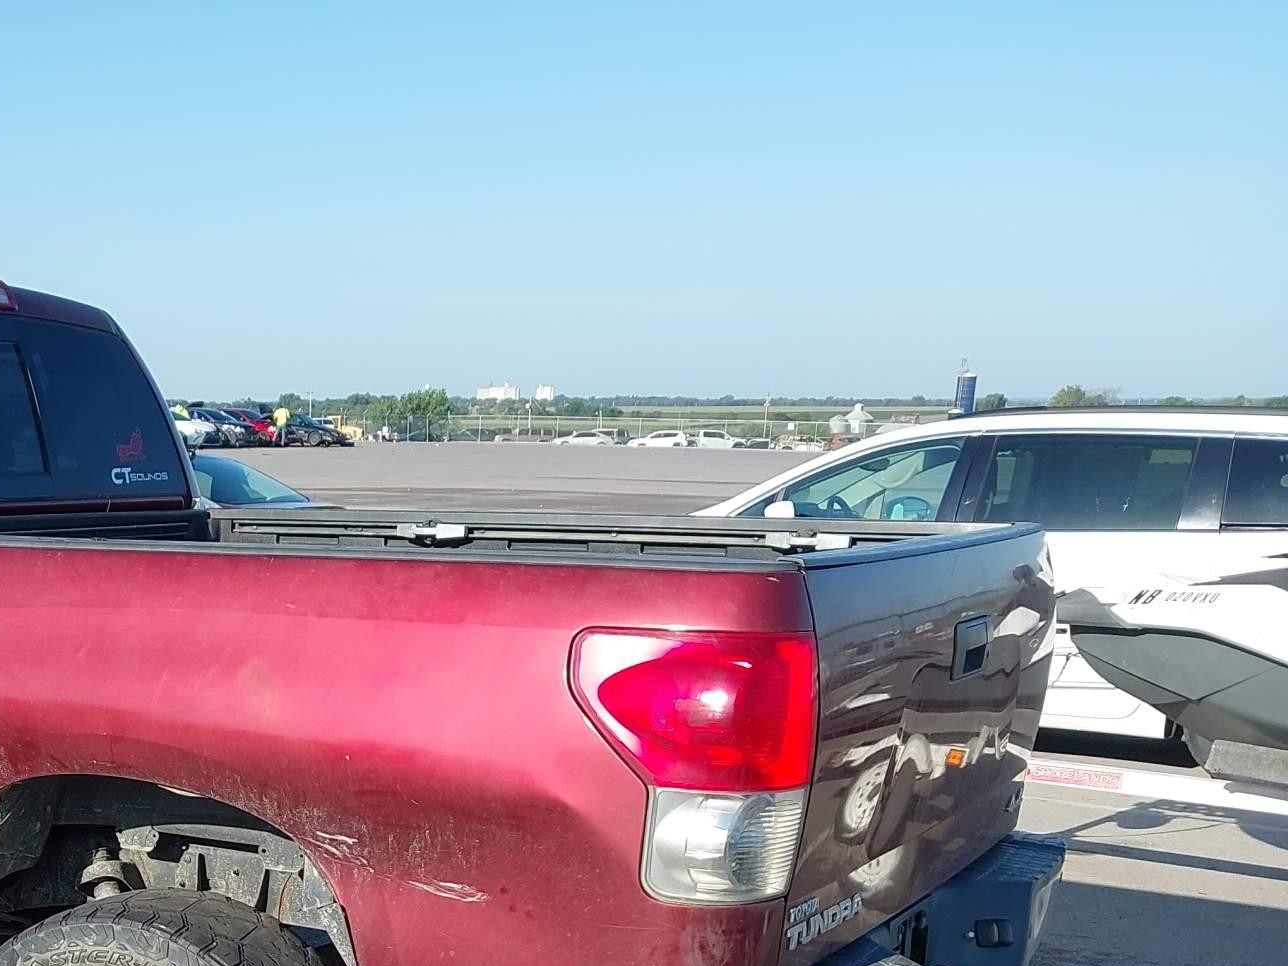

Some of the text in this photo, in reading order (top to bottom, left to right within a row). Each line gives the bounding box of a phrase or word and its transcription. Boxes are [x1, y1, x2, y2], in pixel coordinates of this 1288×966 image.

[1128, 589, 1163, 604] NB
[787, 893, 863, 951] TUNDRA
[790, 897, 820, 923] TOYOTA
